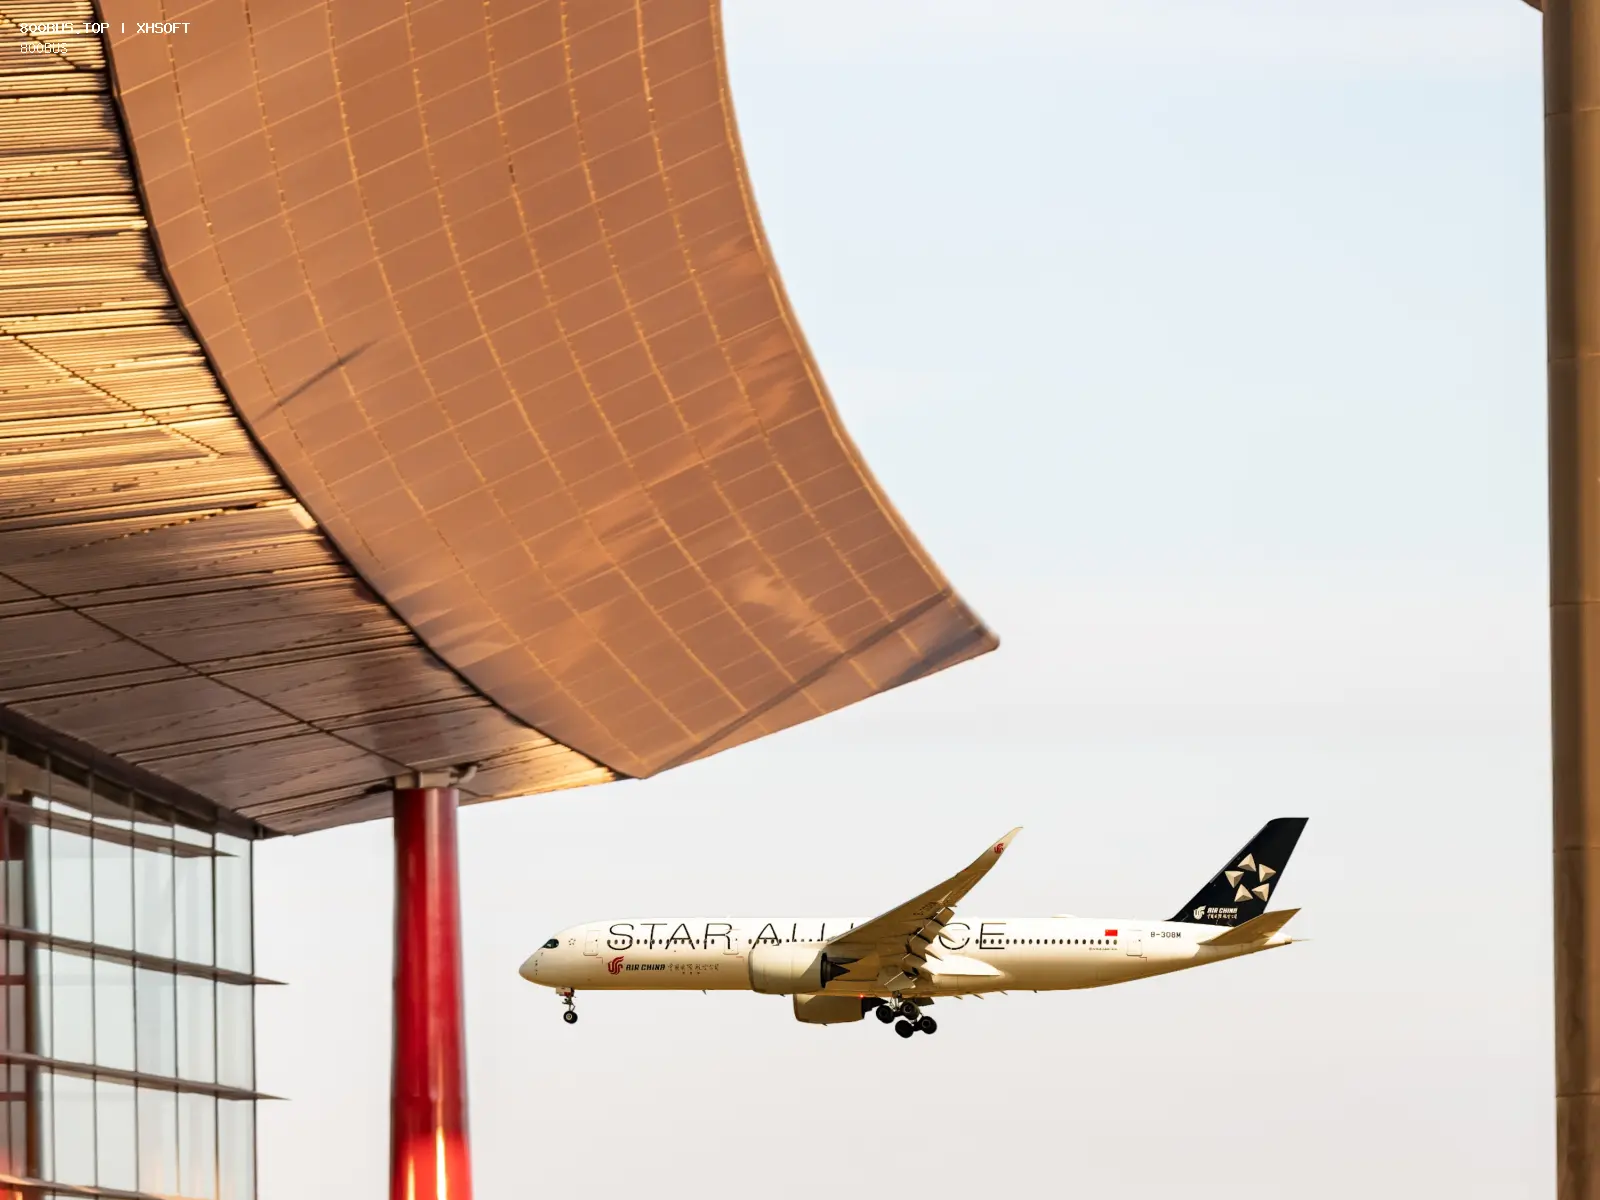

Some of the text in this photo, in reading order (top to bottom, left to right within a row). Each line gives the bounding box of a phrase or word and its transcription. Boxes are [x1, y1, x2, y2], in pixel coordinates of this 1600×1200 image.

[607, 922, 733, 951] STAR
[625, 963, 640, 971] AIR
[641, 963, 666, 971] CHINA
